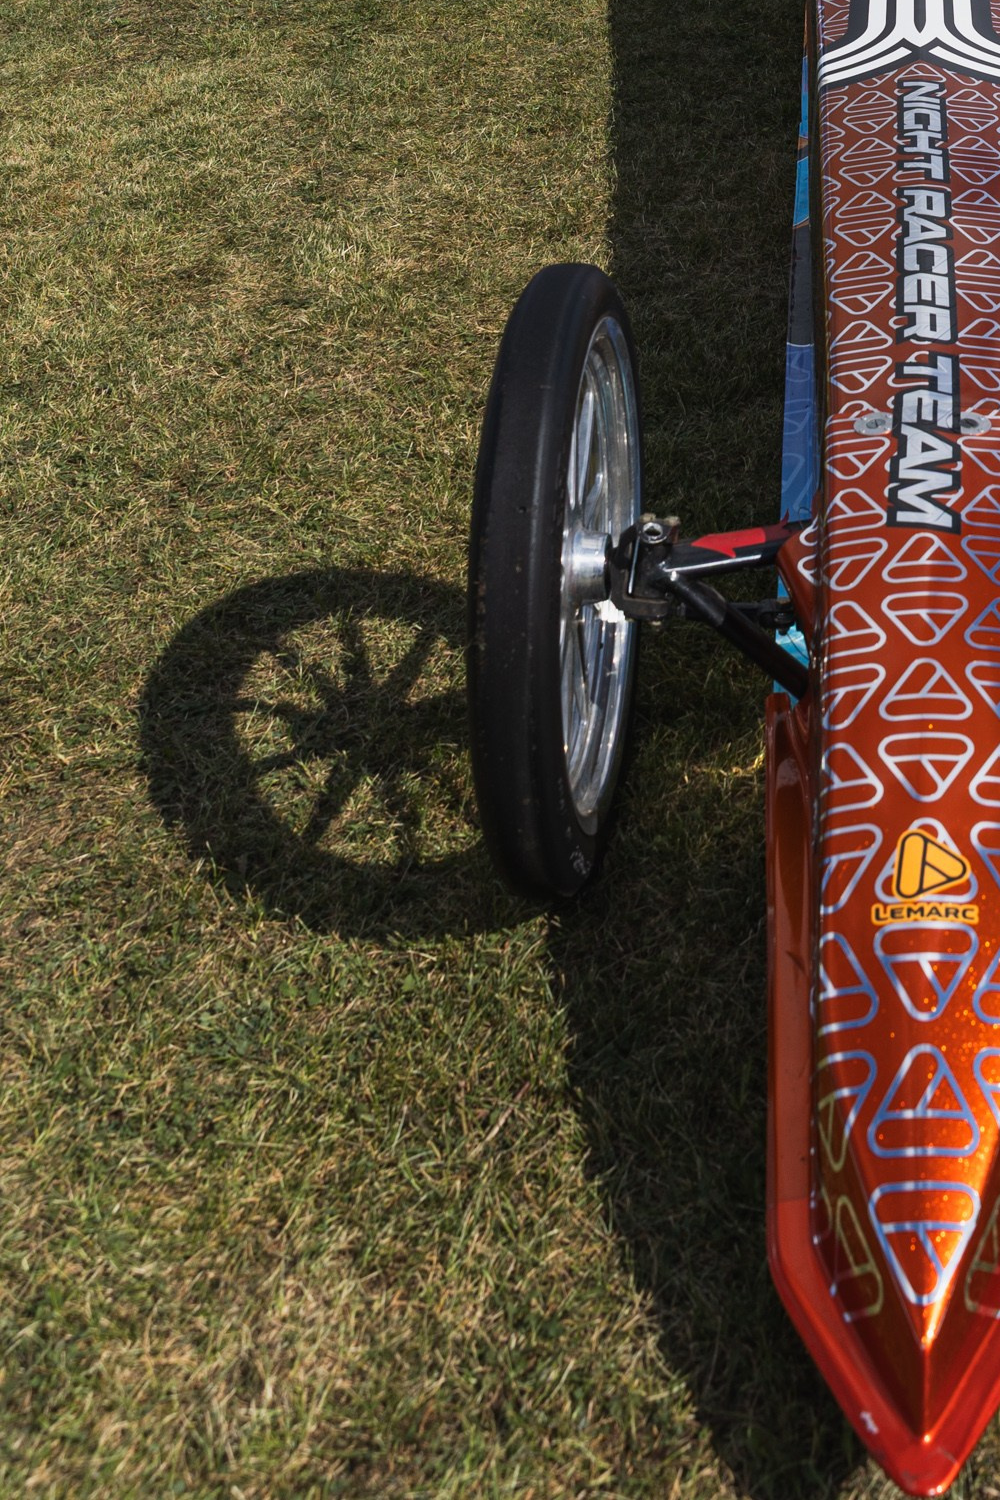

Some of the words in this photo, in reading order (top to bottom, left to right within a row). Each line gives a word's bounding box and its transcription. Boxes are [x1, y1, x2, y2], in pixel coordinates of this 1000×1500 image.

[900, 80, 946, 183] NIGHT
[901, 188, 954, 344] RACER
[896, 355, 957, 529] TEAM
[873, 905, 977, 923] LEMARC
